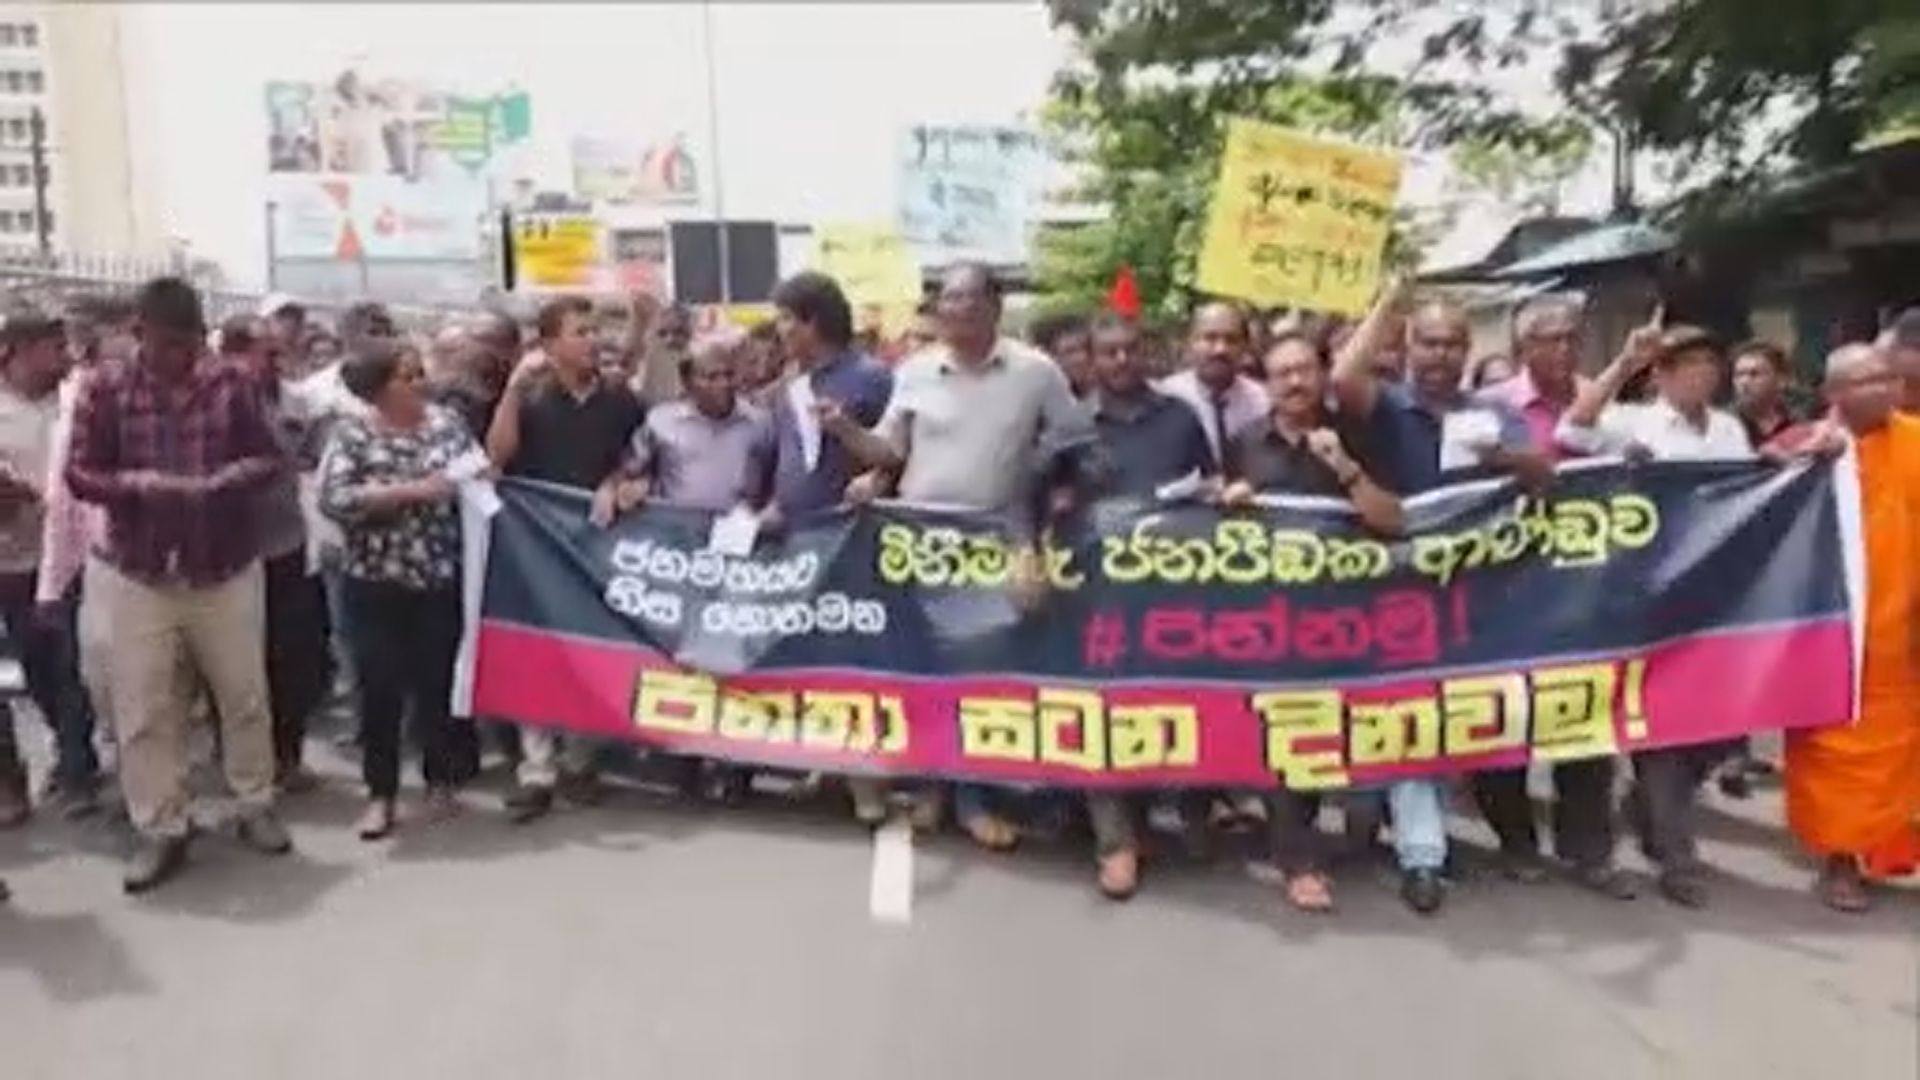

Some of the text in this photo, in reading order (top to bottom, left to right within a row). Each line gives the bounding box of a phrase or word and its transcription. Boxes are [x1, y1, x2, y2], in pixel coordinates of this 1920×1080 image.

[1102, 514, 1391, 582] ජනපීඩක
[1411, 494, 1659, 586] ආණ්ඩුව
[633, 669, 908, 752] ජනතා
[959, 688, 1200, 770] සටන
